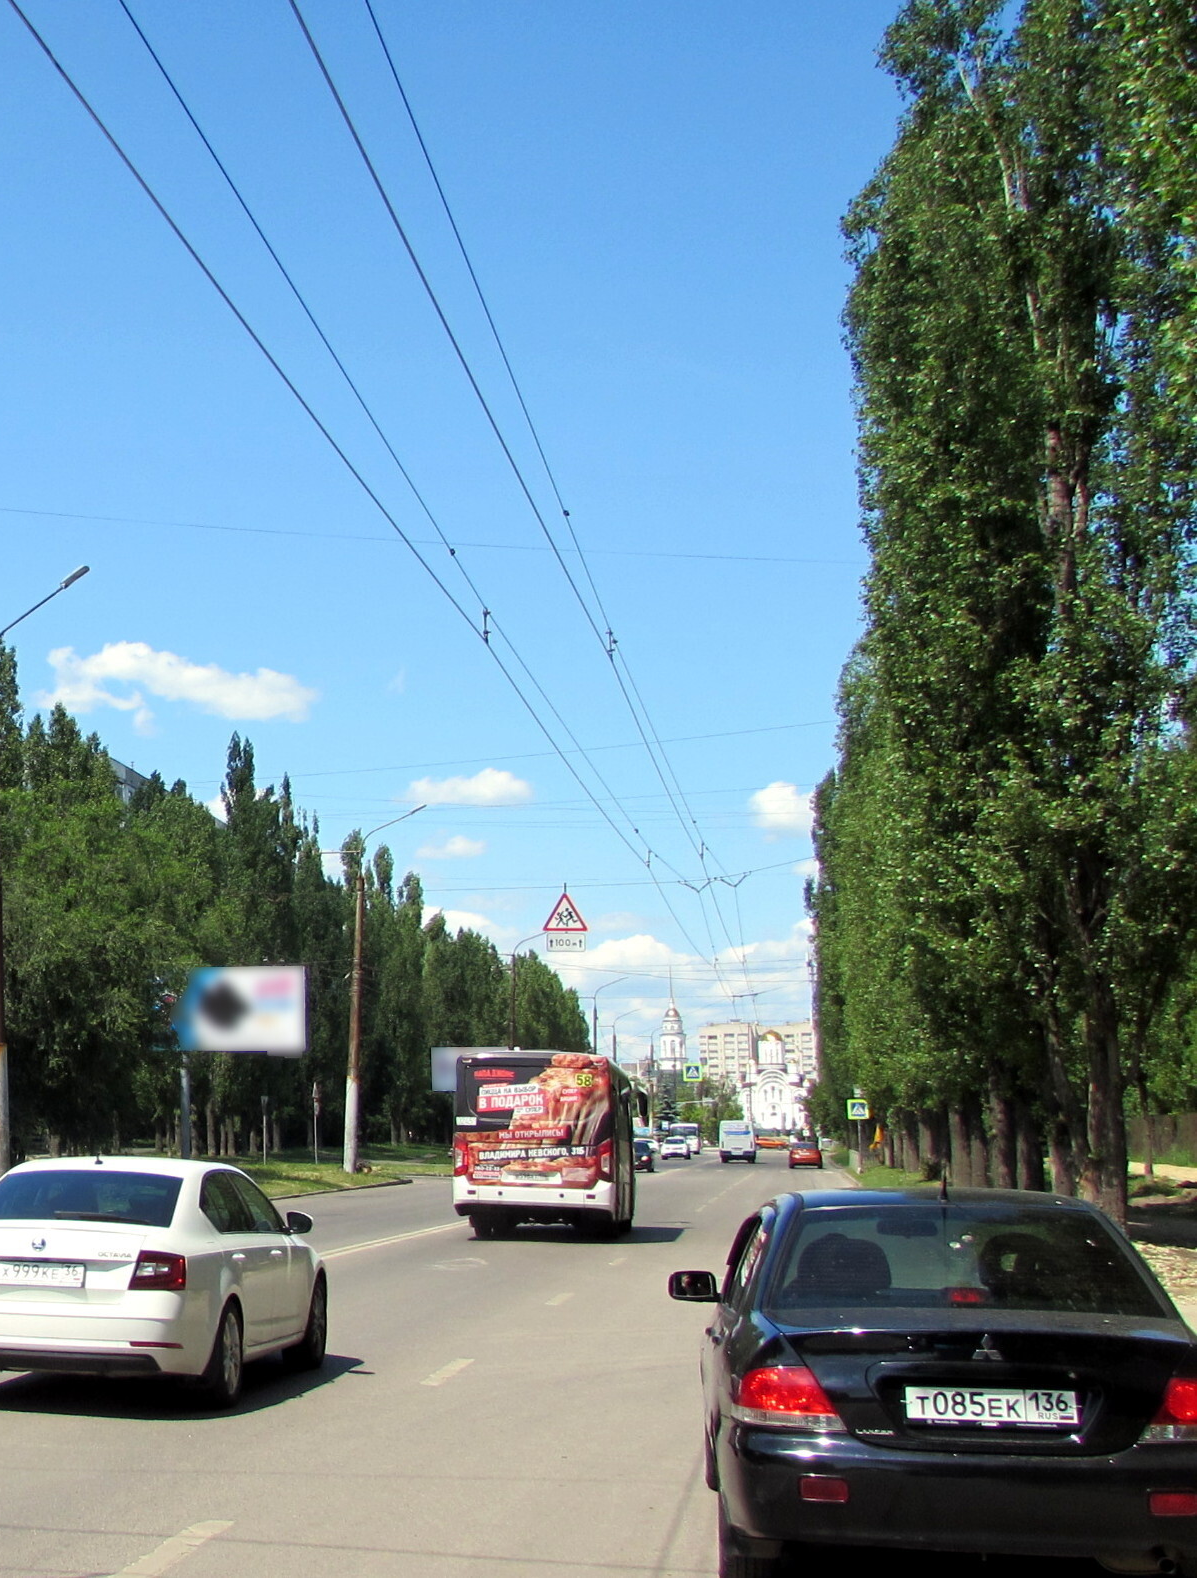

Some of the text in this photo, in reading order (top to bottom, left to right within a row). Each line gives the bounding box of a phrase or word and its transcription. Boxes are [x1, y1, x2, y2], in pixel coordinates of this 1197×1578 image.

[555, 939, 571, 947] 100
[576, 1074, 592, 1086] 58
[514, 1085, 537, 1093] ВЫБОР
[479, 1097, 487, 1109] В
[490, 1094, 544, 1109] ПОДАРОК
[498, 1131, 513, 1139] МЫ
[478, 1150, 526, 1160] ВЛАДИМИРА
[97, 1251, 132, 1259] OCTAVIA
[64, 1265, 78, 1277] 36
[1028, 1391, 1069, 1412] 136
[1038, 1412, 1059, 1420] RUS
